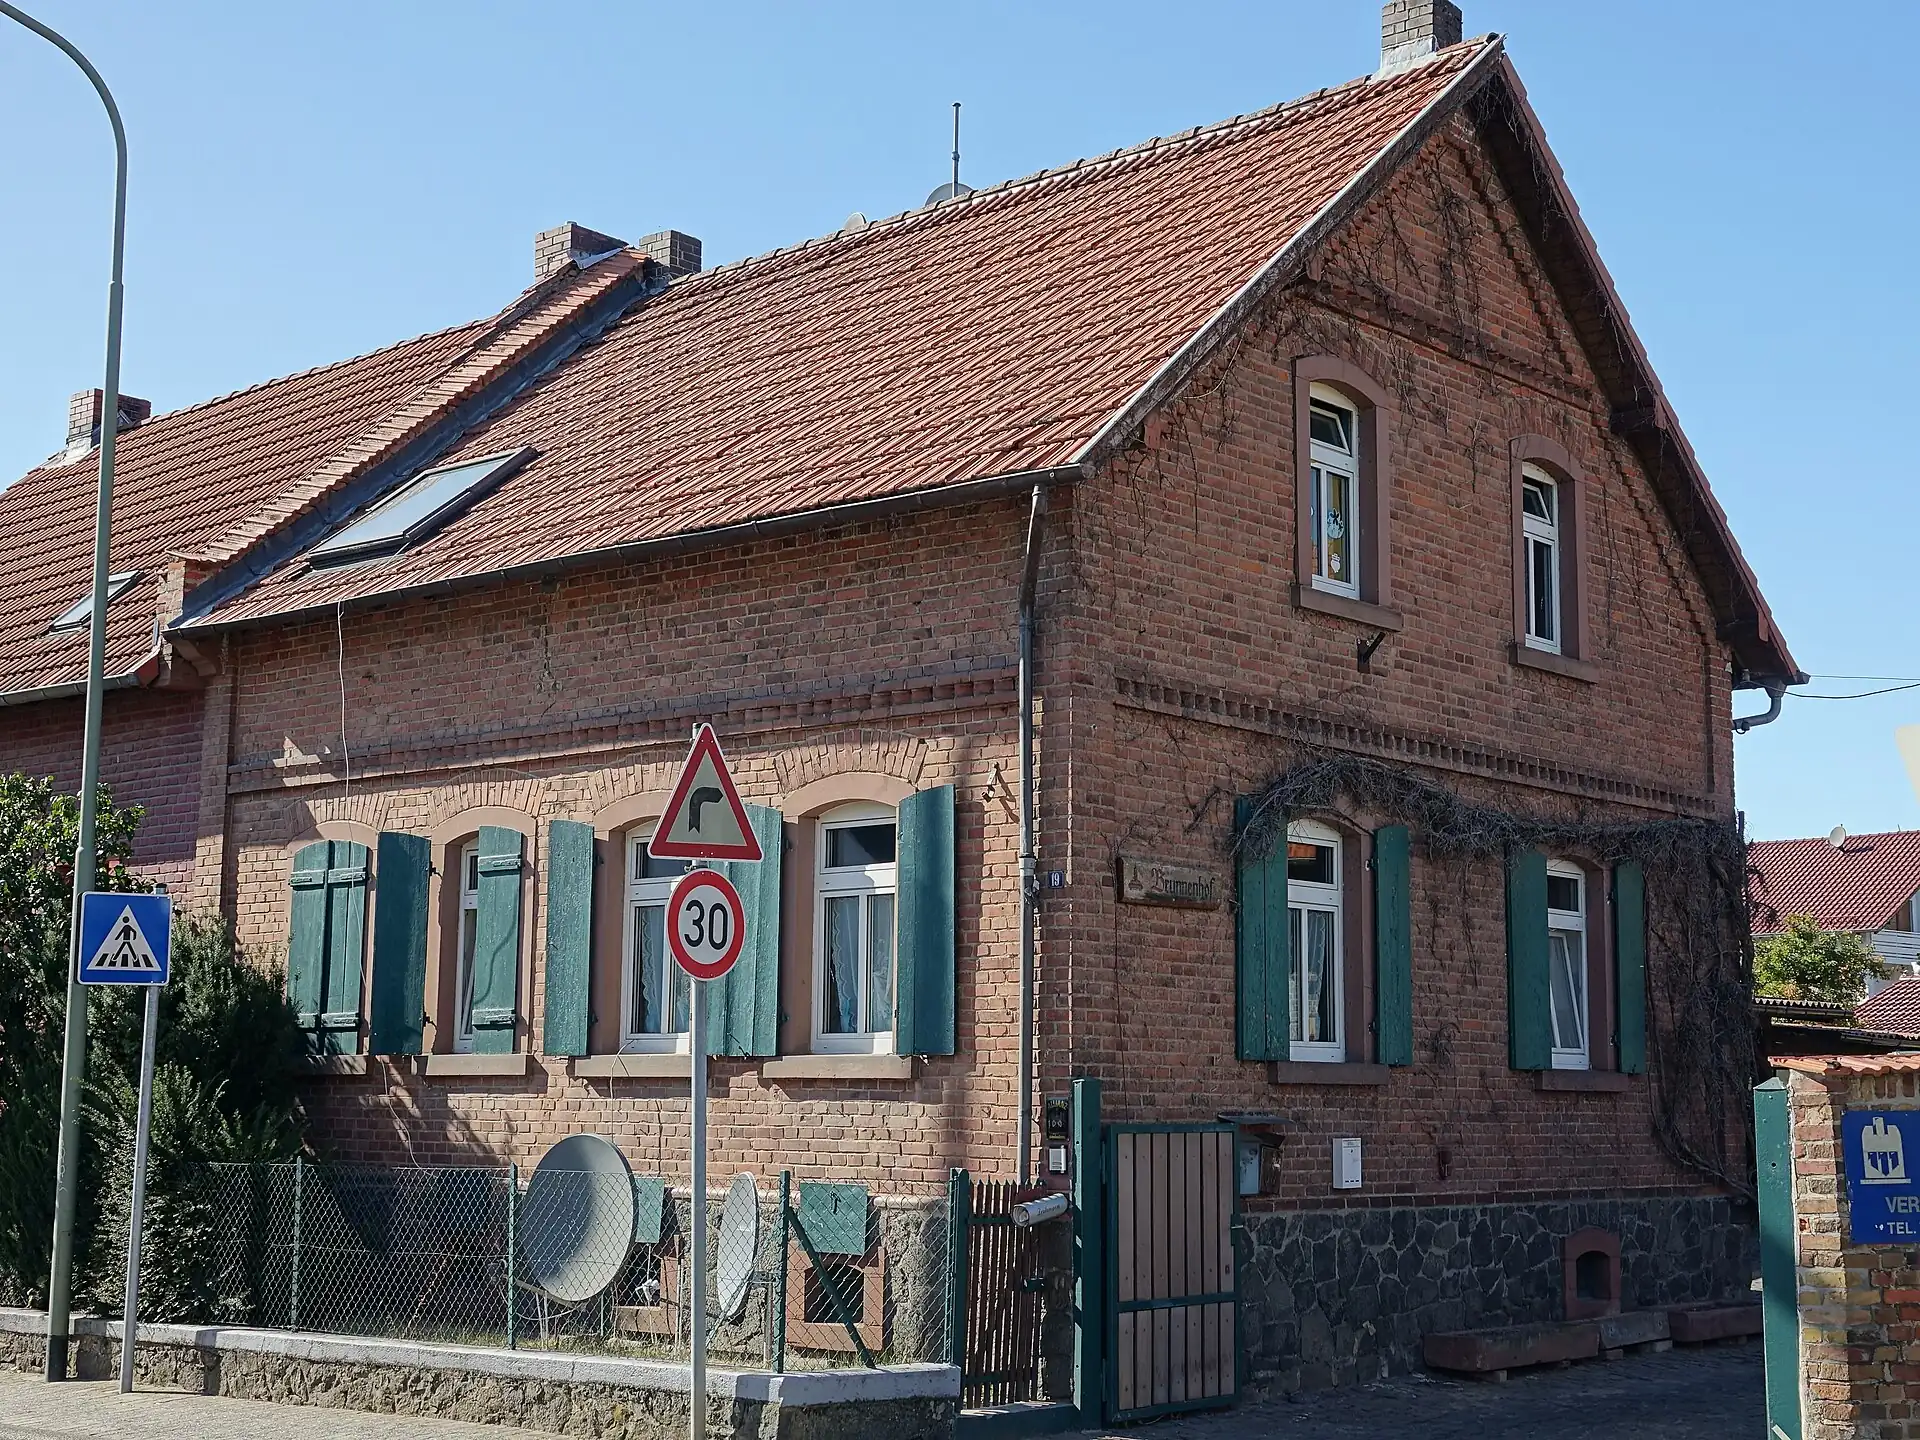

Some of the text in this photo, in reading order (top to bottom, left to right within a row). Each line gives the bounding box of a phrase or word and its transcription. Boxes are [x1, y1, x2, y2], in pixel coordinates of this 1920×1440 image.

[1051, 872, 1060, 887] 19
[1151, 867, 1216, 900] Brunnenhof
[684, 899, 728, 950] 30
[1885, 1196, 1920, 1213] VER
[1887, 1221, 1917, 1235] TEL.
